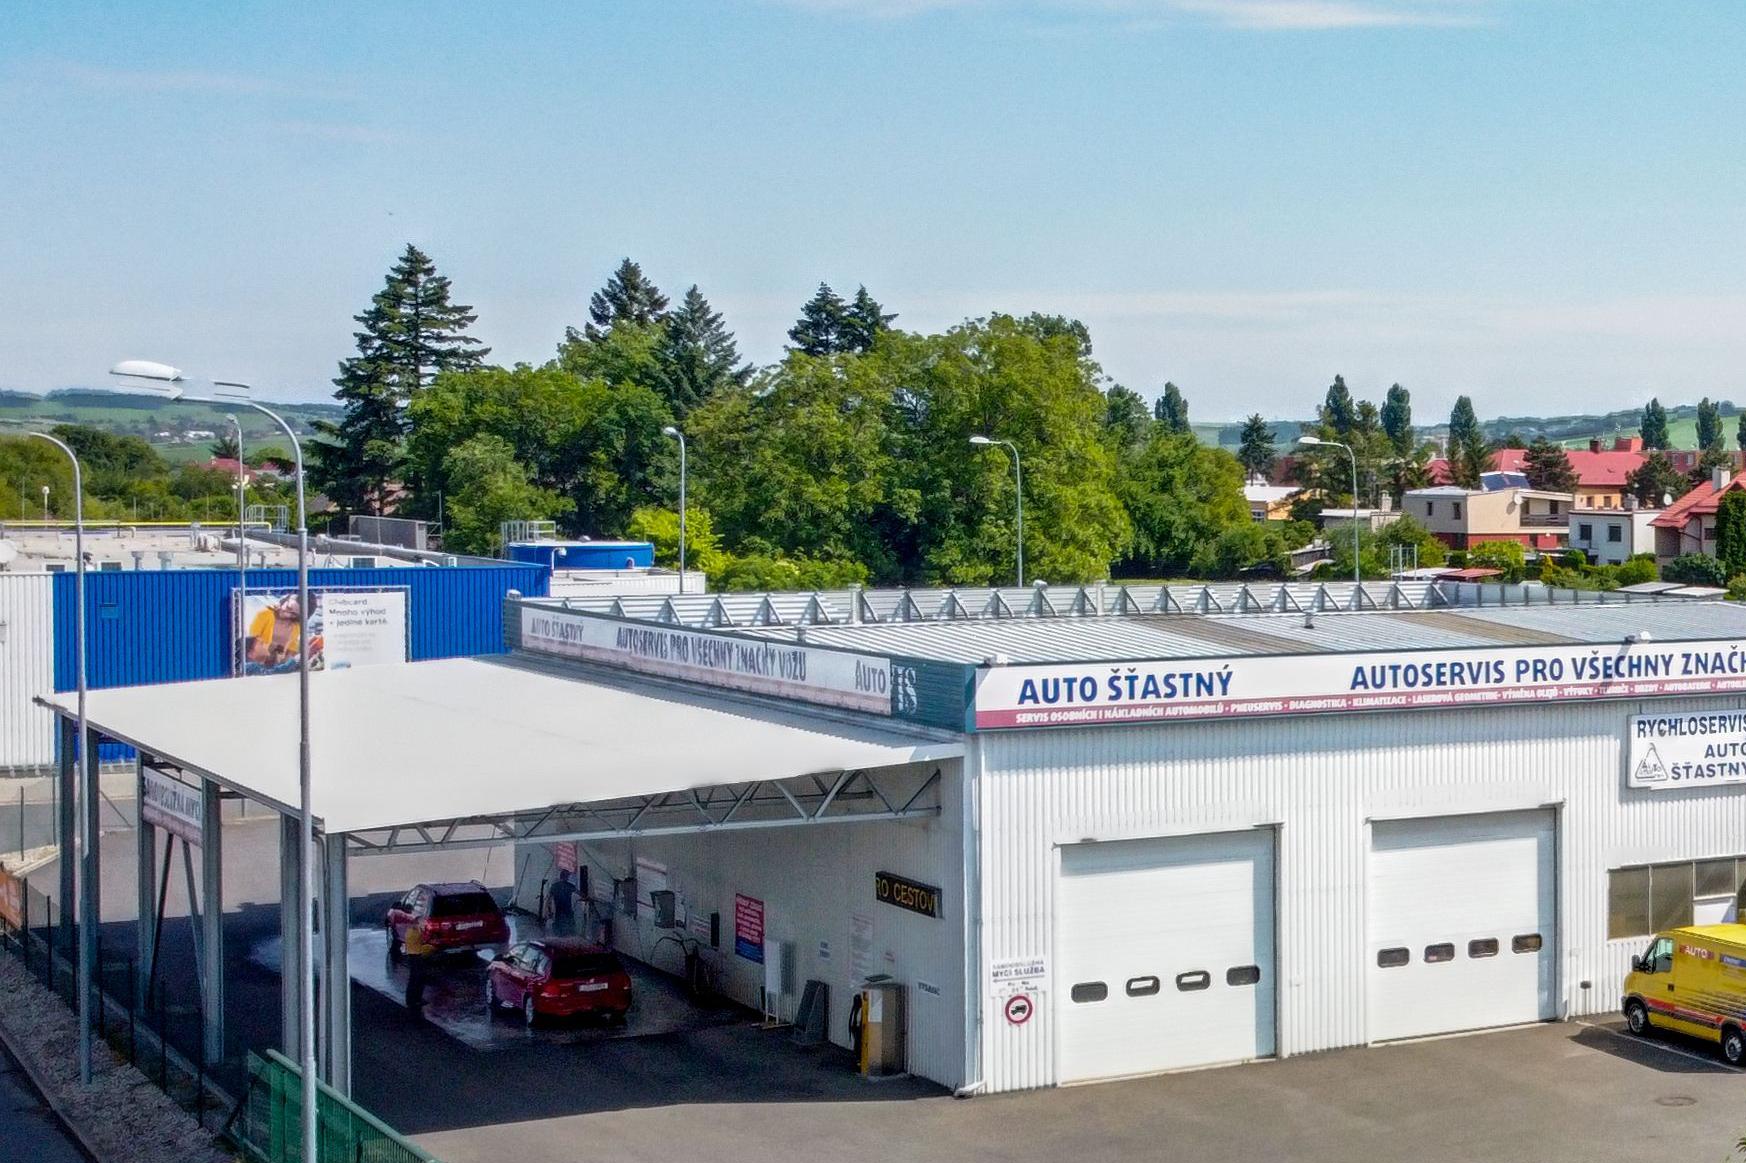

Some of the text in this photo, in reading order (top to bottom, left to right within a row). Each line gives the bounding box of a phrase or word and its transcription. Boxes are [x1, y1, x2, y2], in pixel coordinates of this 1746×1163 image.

[531, 617, 550, 637] AUTO
[616, 627, 668, 660] AUTOSERVIS
[670, 634, 689, 663] PRO
[1017, 664, 1233, 705] AUTO ŠŤASTNÝ
[1350, 660, 1505, 690] AUTOSERVIS
[1516, 658, 1564, 682] PRO
[1571, 650, 1674, 680] VŠECHNY
[1016, 711, 1048, 724] SERVIS
[1050, 708, 1098, 722] OSOBNÍCH
[1104, 705, 1164, 719] NÁKLADNÍCH
[1165, 701, 1224, 716] AUTOMOBILŮ
[1231, 701, 1283, 713] PNEUSERVIS
[1290, 698, 1347, 710] DIAGNOSTIKA
[1353, 695, 1407, 707] KLIMATIZACE
